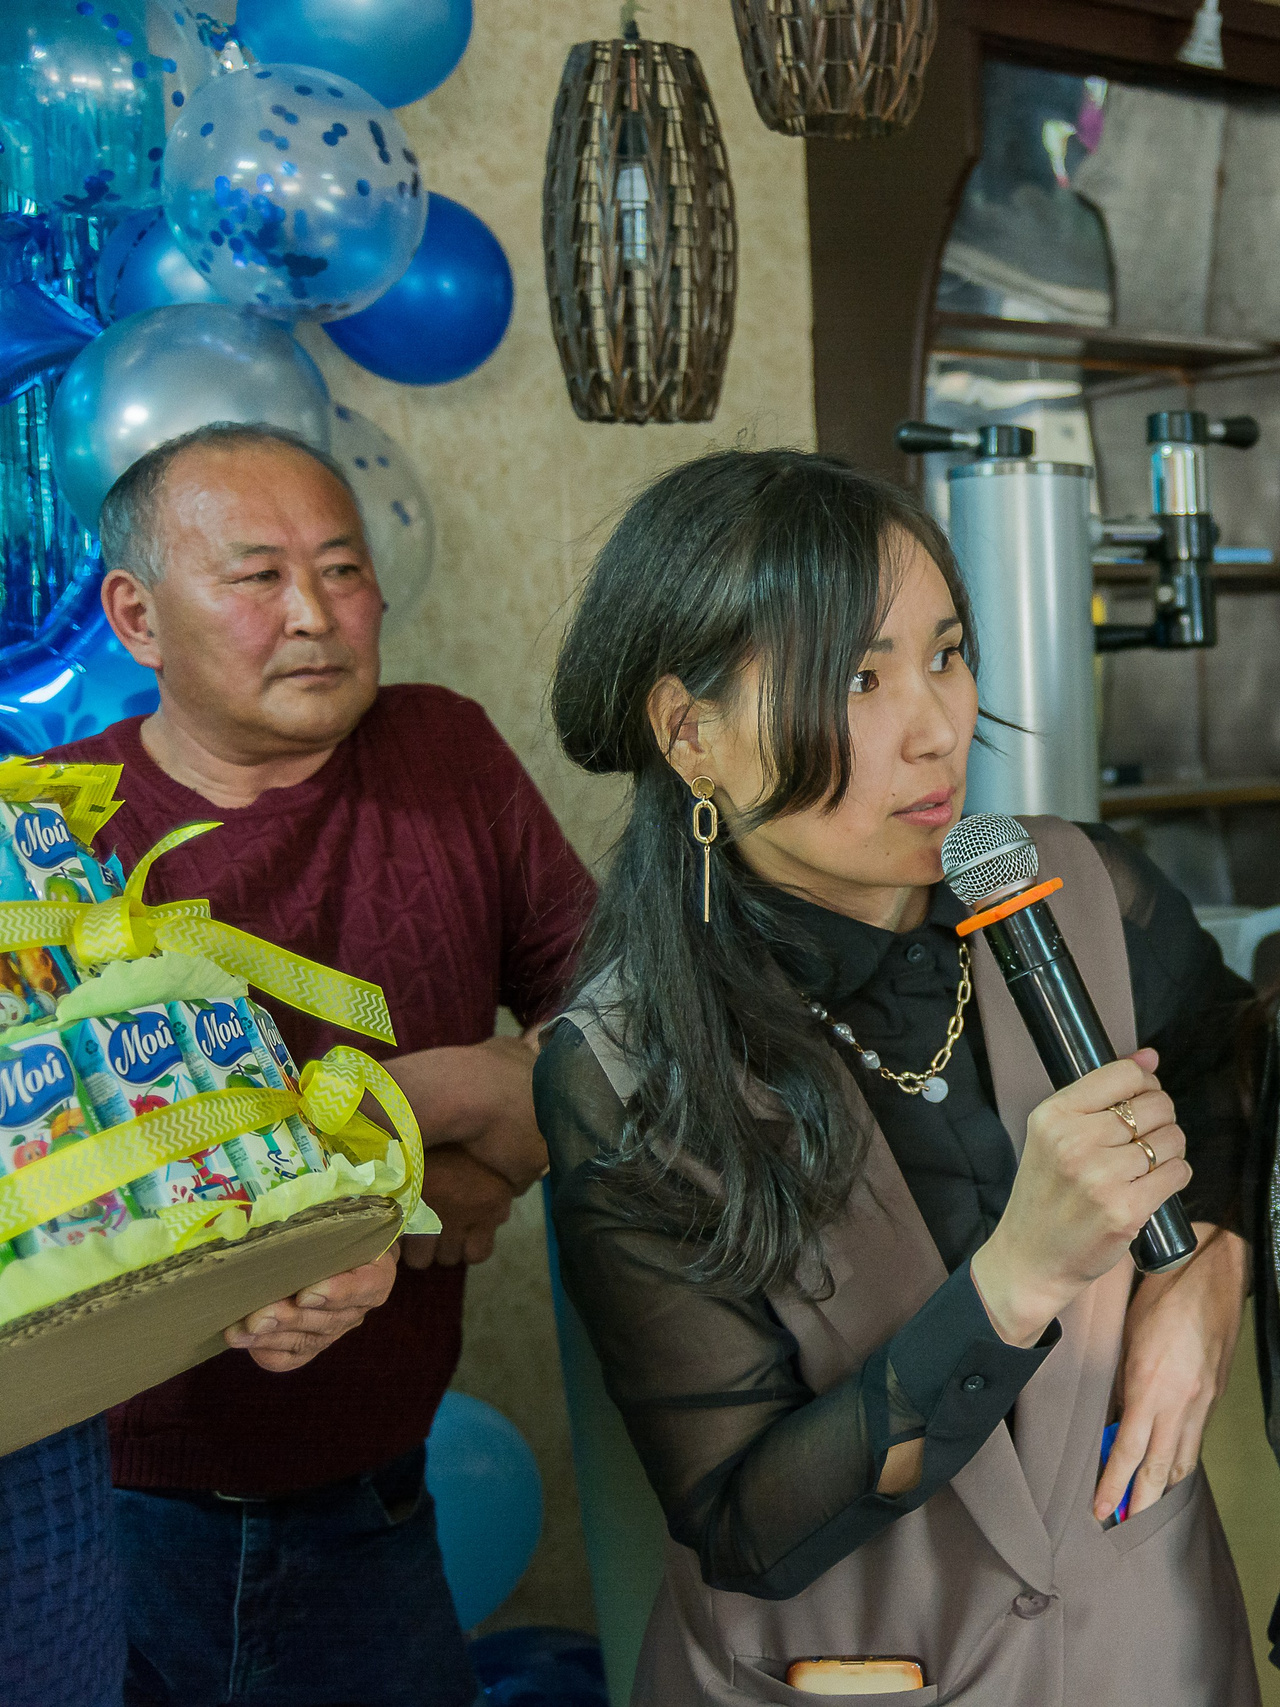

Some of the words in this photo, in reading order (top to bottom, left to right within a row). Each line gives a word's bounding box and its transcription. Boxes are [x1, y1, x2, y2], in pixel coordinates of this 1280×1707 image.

[20, 815, 70, 857] Мой
[114, 1020, 175, 1075] Мой
[202, 1011, 245, 1057] Мой
